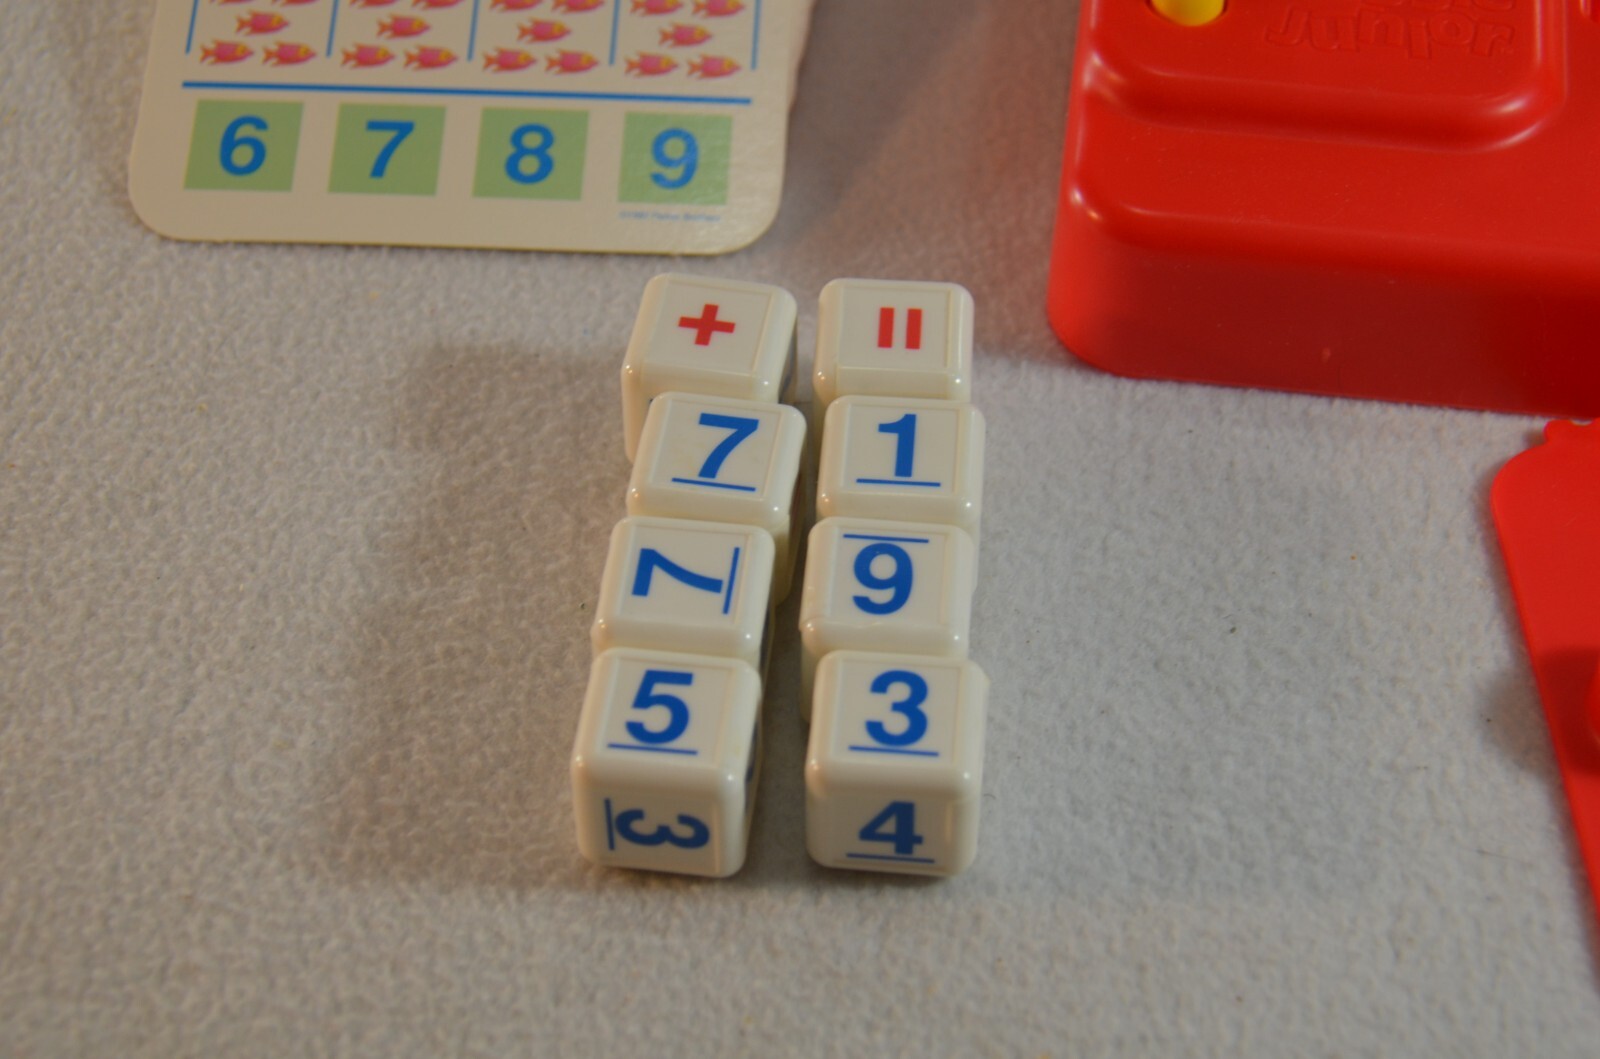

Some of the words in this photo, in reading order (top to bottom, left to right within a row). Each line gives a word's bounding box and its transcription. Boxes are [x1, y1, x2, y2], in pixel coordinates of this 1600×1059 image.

[1264, 4, 1516, 60] Junior
[218, 114, 269, 177] 6
[365, 120, 415, 179] 7
[504, 122, 555, 185] 8
[650, 128, 699, 190] 9
[698, 412, 759, 479] 7
[878, 413, 917, 478] 1
[632, 547, 723, 597] 7
[625, 669, 694, 746] 5
[865, 669, 930, 747] 3
[615, 808, 710, 849] 3
[858, 800, 924, 856] 4
